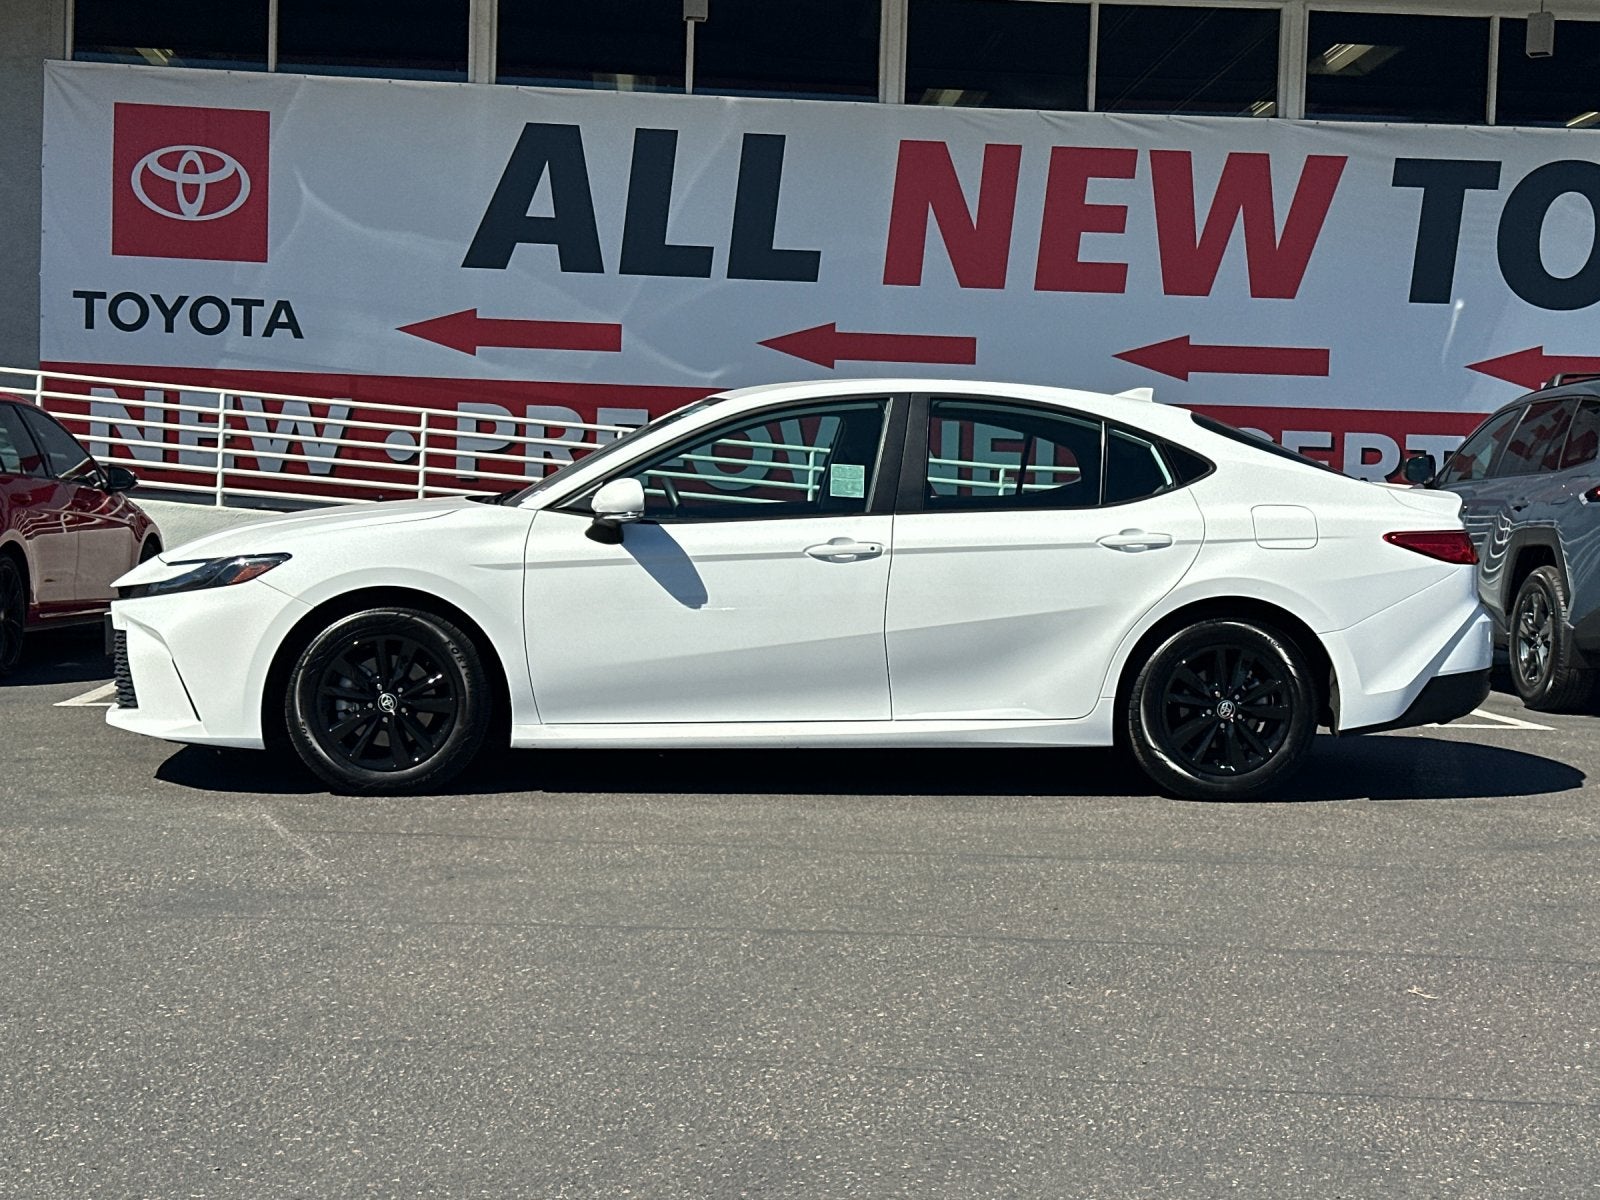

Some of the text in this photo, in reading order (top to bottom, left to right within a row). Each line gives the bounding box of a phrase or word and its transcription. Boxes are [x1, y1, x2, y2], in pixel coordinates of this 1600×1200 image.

[461, 122, 1600, 311] ALL NEW TO
[72, 290, 304, 340] TOYOTA
[89, 387, 353, 475] NEW
